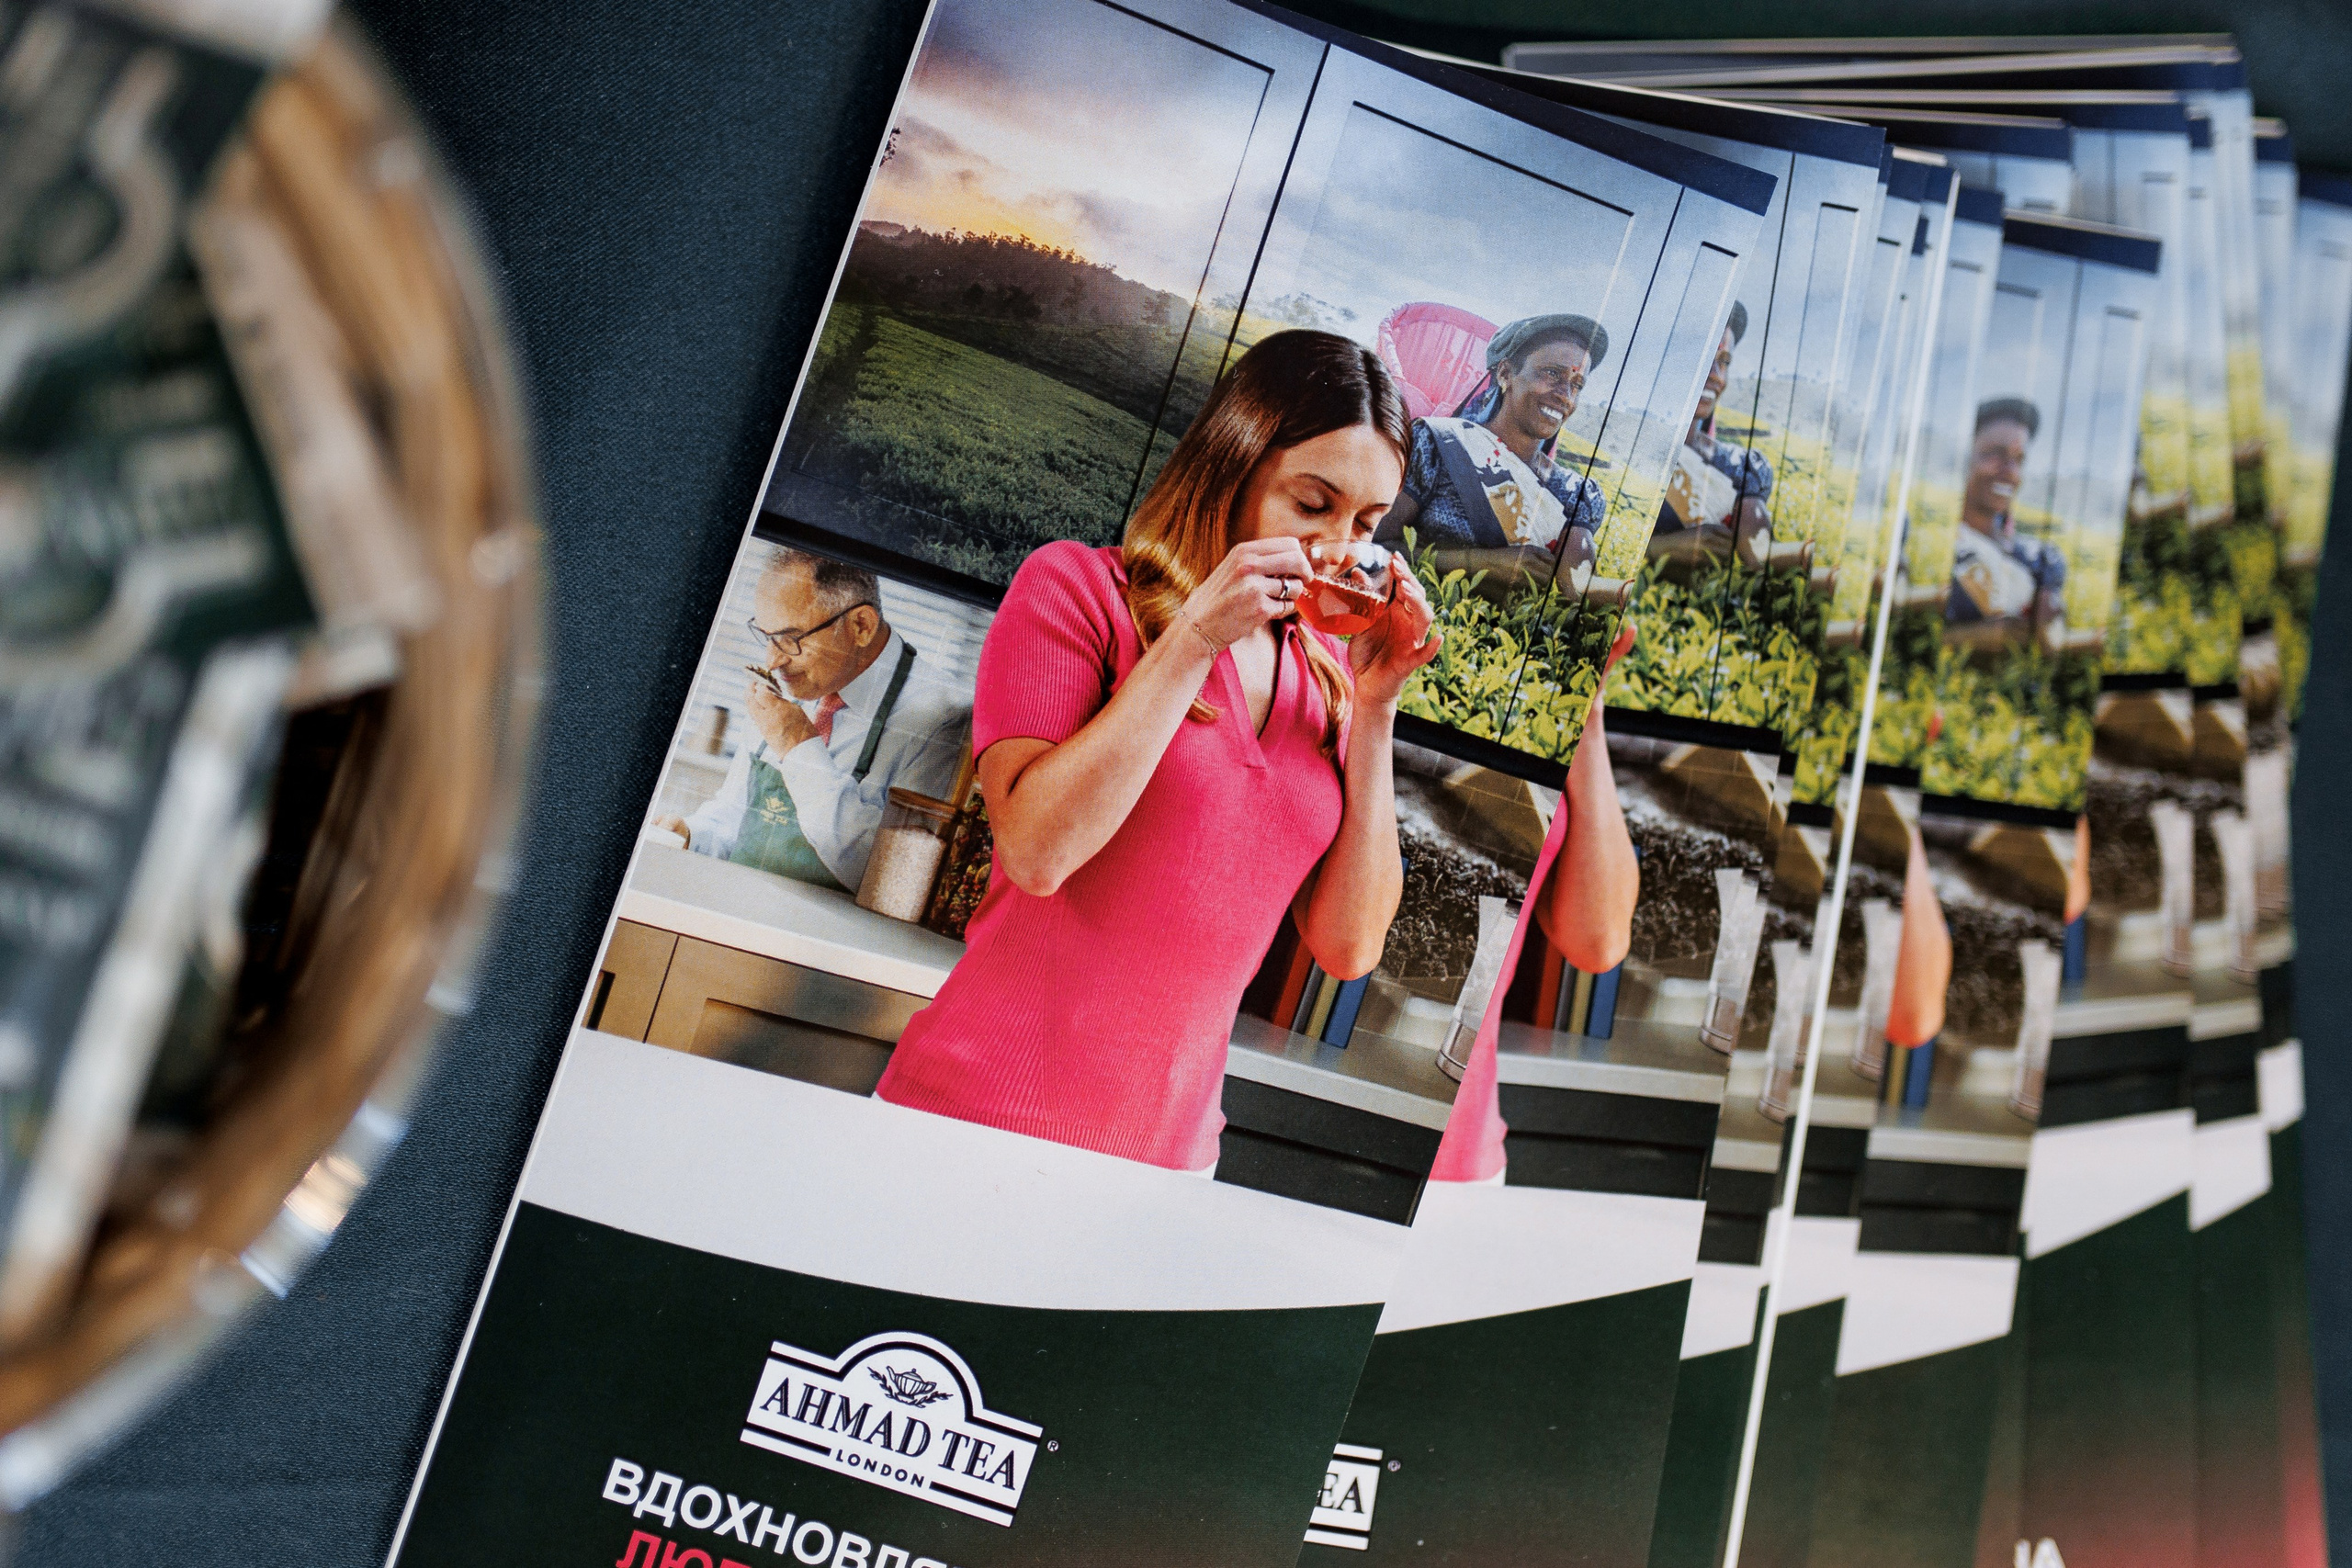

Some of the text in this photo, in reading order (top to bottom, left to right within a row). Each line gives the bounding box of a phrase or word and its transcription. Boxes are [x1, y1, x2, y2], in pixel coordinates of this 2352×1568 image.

[760, 1377, 932, 1458] AHMAD
[937, 1427, 1016, 1491] TEA
[835, 1449, 925, 1488] LONDON
